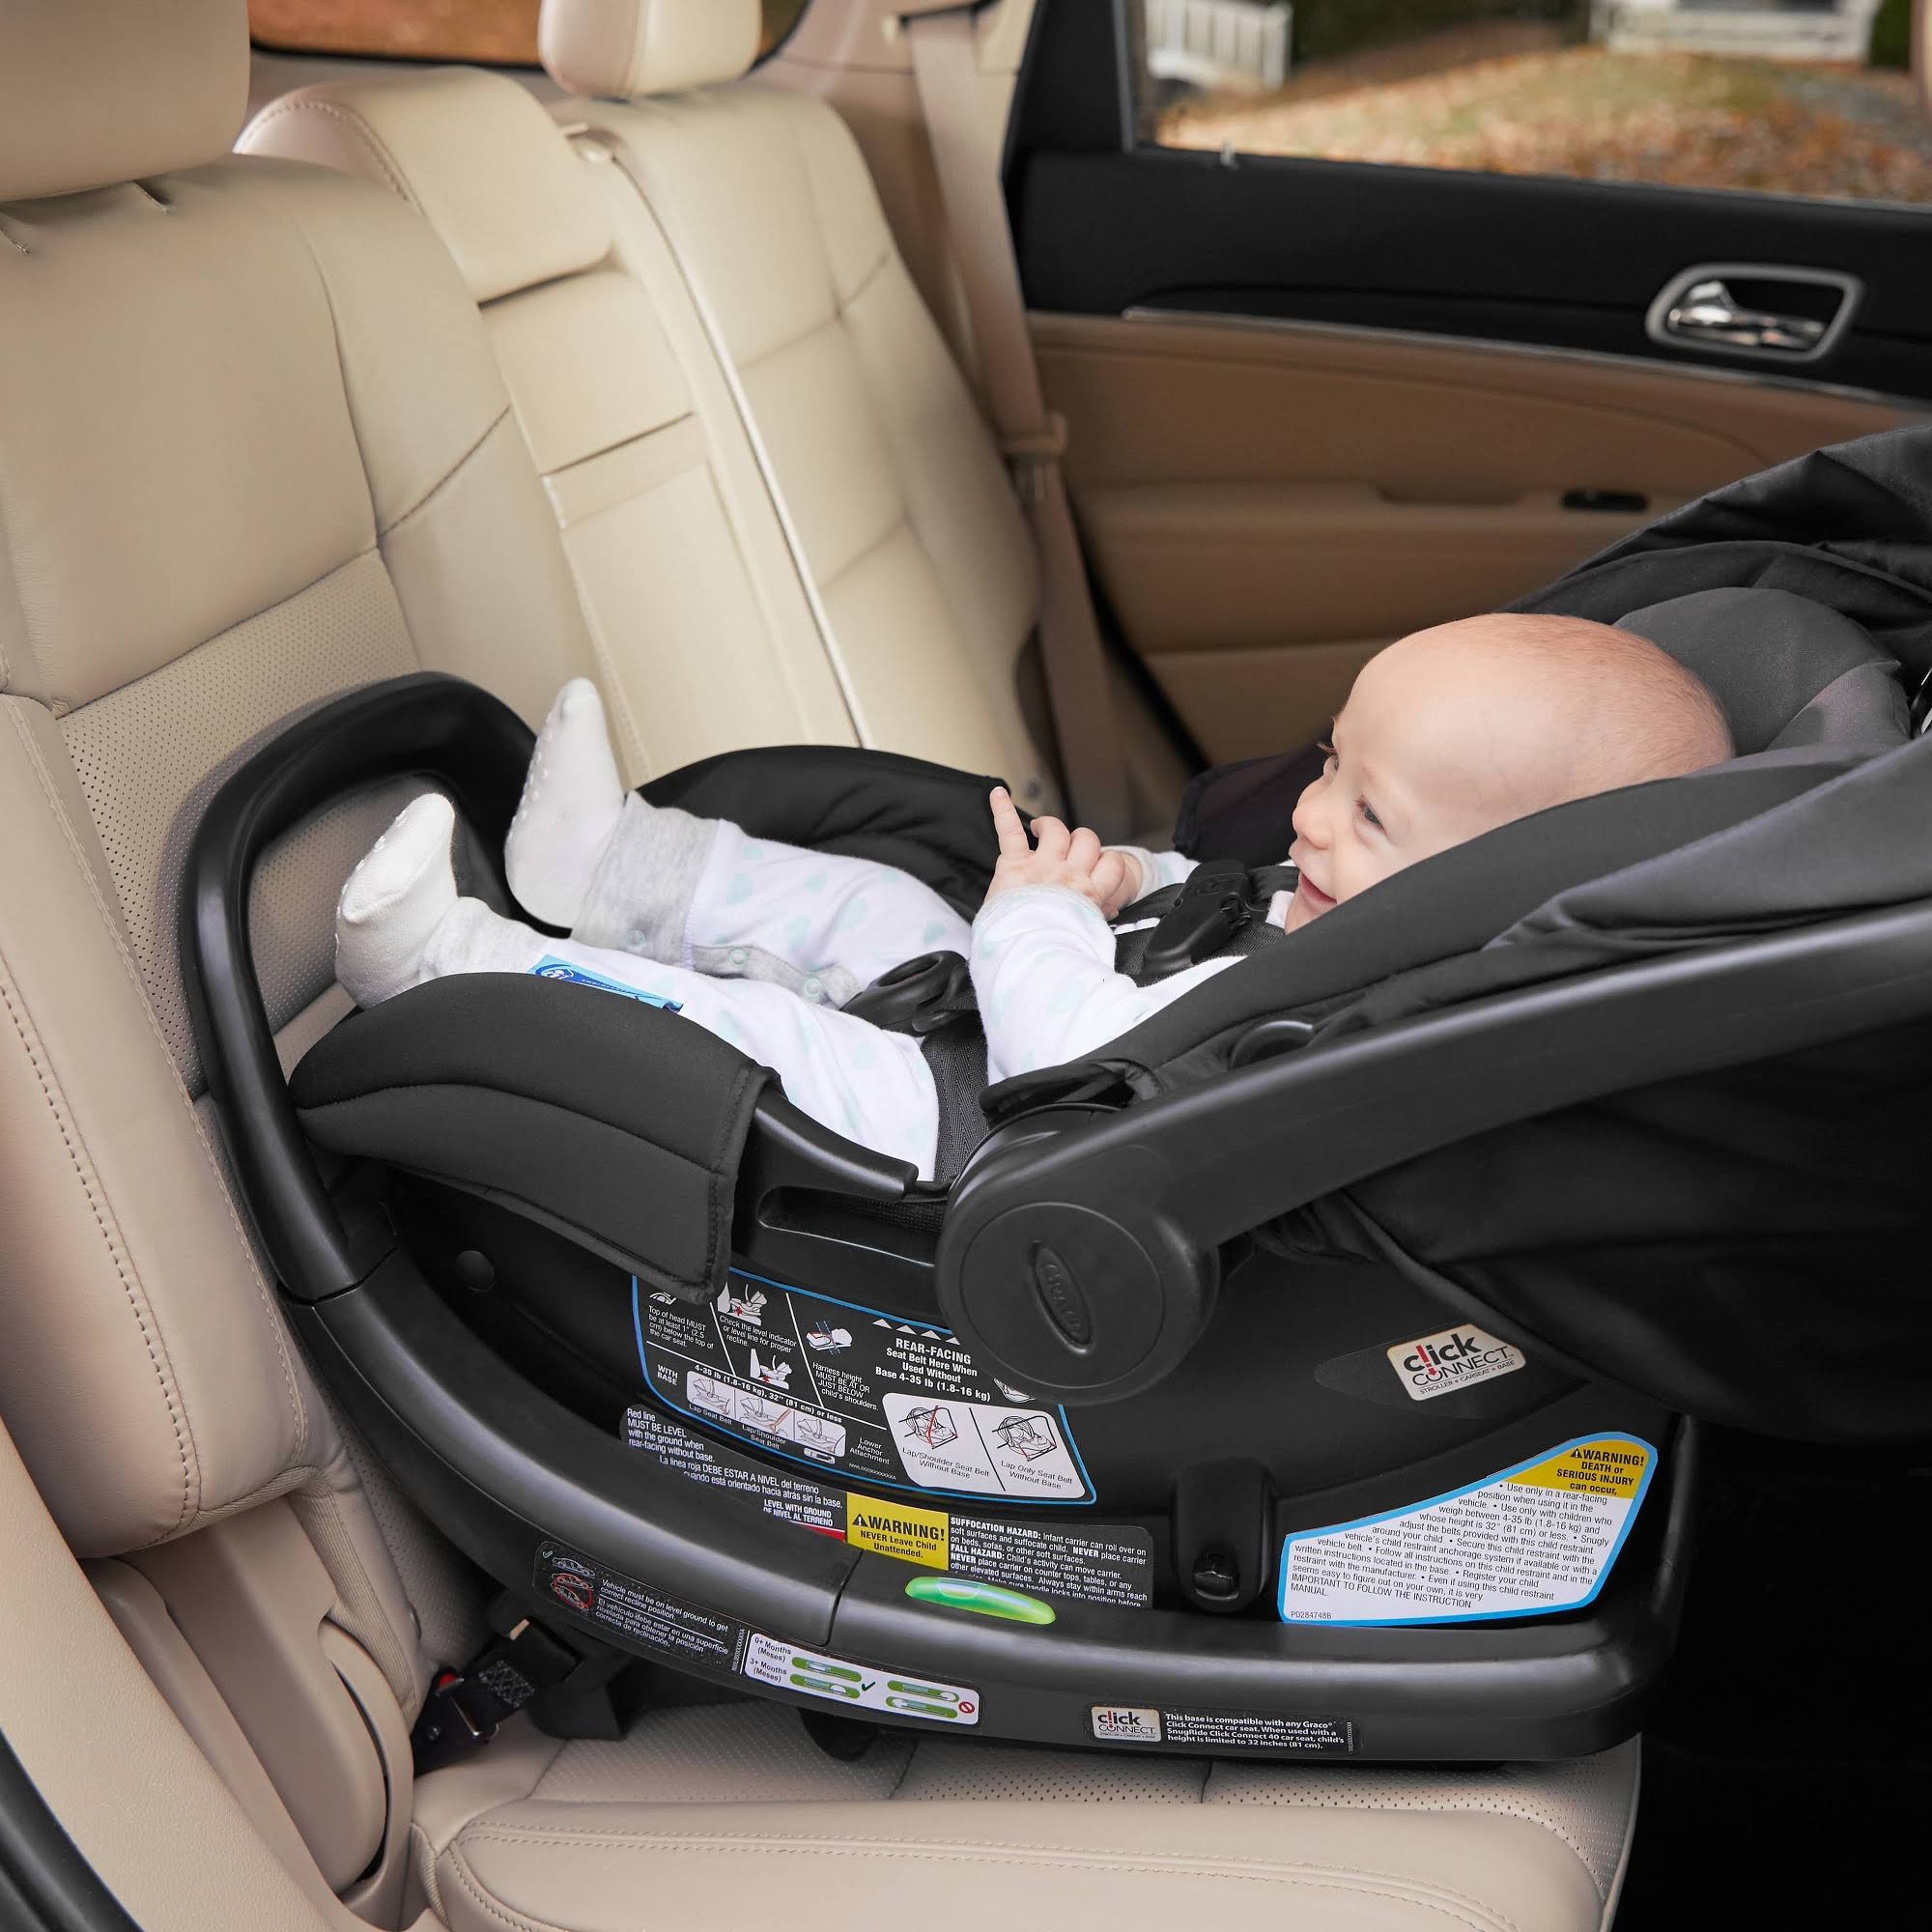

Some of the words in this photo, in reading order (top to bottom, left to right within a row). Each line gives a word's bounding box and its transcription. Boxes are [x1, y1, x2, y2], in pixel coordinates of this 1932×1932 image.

[719, 1315, 740, 1327] Check
[741, 1322, 751, 1331] the
[753, 1326, 767, 1337] level
[768, 1332, 796, 1347] indicator
[726, 1334, 749, 1347] recline.
[731, 1326, 746, 1337] level
[747, 1333, 758, 1342] line
[770, 1342, 791, 1352] proper
[896, 1338, 970, 1364] REAR-FACING
[1404, 1334, 1482, 1372] click
[658, 1364, 677, 1378] WITH
[812, 1361, 839, 1376] Harness
[841, 1371, 862, 1383] height
[887, 1348, 906, 1359] Seat
[909, 1353, 925, 1364] Belt
[929, 1357, 950, 1370] Here
[952, 1363, 977, 1377] When
[902, 1362, 923, 1374] Used
[926, 1368, 960, 1382] Without
[1412, 1347, 1508, 1385] CONNECT
[657, 1372, 676, 1385] BASE
[815, 1370, 837, 1381] MUST
[838, 1378, 847, 1386] BE
[848, 1379, 858, 1389] AT
[859, 1384, 869, 1393] OR
[875, 1366, 896, 1378] Base
[899, 1373, 921, 1384] 4-35
[924, 1378, 933, 1387] lb
[937, 1381, 972, 1396] (1.8-16
[976, 1389, 990, 1401] kg)
[1420, 1380, 1453, 1394] STROLLER
[1461, 1368, 1490, 1382] CARSEAT
[1497, 1360, 1515, 1370] BASE
[695, 1364, 712, 1376] 4-35
[724, 1376, 751, 1390] (1.8-16
[769, 1392, 783, 1401] 32"
[785, 1399, 797, 1407] (81
[800, 1405, 814, 1414] cm)
[827, 1412, 841, 1423] less
[818, 1379, 837, 1389] JUST
[838, 1385, 864, 1398] BELOW
[821, 1388, 842, 1399] child's
[844, 1395, 878, 1410] shoulders.
[627, 1407, 641, 1418] Red
[643, 1411, 655, 1421] line
[628, 1418, 649, 1430] MUST
[651, 1423, 661, 1433] BE
[663, 1425, 687, 1437] LEVEL
[628, 1429, 642, 1437] with
[644, 1432, 655, 1440] the
[657, 1435, 682, 1446] ground
[684, 1439, 703, 1450] when
[629, 1438, 666, 1454] rear-facing
[668, 1446, 694, 1459] without
[696, 1451, 715, 1462] base.
[1582, 1449, 1644, 1466] WARNING!
[1001, 1461, 1015, 1469] Lap
[1018, 1464, 1036, 1475] Only
[1037, 1469, 1055, 1479] Seat
[1057, 1474, 1071, 1484] Belt
[1557, 1468, 1596, 1481] SERIOUS
[1600, 1474, 1634, 1486] INJURY
[1581, 1462, 1611, 1472] DEATH
[1009, 1471, 1039, 1484] Without
[1041, 1479, 1061, 1489] Base
[1590, 1485, 1616, 1495] occur,
[1478, 1491, 1510, 1501] position
[1513, 1495, 1535, 1504] when
[1538, 1499, 1560, 1510] using
[1563, 1501, 1568, 1510] it
[1580, 1503, 1593, 1512] the
[1507, 1483, 1522, 1492] Use
[1525, 1487, 1543, 1497] only
[1546, 1488, 1552, 1496] in
[1563, 1492, 1607, 1505] rear-facing
[764, 1499, 783, 1509] LEVEL
[784, 1502, 802, 1513] WITH
[804, 1506, 831, 1518] GROUND
[1459, 1498, 1487, 1508] vehicle.
[1501, 1503, 1517, 1513] Use
[1519, 1507, 1537, 1517] only
[1559, 1512, 1591, 1522] children
[1594, 1517, 1611, 1525] who
[867, 1516, 944, 1541] WARNING!
[1438, 1506, 1463, 1516] weigh
[1464, 1508, 1499, 1520] between
[1502, 1514, 1521, 1523] 4-35
[1535, 1519, 1566, 1529] (1.8-16
[1569, 1522, 1581, 1533] kg)
[861, 1530, 887, 1542] NEVER
[890, 1535, 913, 1547] Leave
[916, 1540, 936, 1550] Child
[951, 1517, 1004, 1533] SUFFOCATION
[1007, 1526, 1040, 1539] HAZARD:
[1043, 1532, 1063, 1543] Infant
[1065, 1537, 1088, 1547] carrier
[873, 1542, 923, 1557] Unattended.
[966, 1530, 997, 1541] surfaces
[1014, 1538, 1047, 1548] suffocate
[1049, 1544, 1067, 1552] child.
[1072, 1547, 1098, 1557] NEVER
[1101, 1551, 1120, 1560] place
[1122, 1555, 1146, 1564] carrier
[1291, 1582, 1328, 1596] MANUAL.
[1292, 1573, 1341, 1587] IMPORTANT
[1344, 1581, 1354, 1590] TO
[1356, 1583, 1392, 1596] FOLLOW
[1396, 1589, 1410, 1599] THE
[1413, 1592, 1470, 1607] INSTRUCTION
[602, 1578, 626, 1593] Vehicle
[627, 1590, 644, 1601] must
[645, 1596, 654, 1605] be
[666, 1604, 682, 1614] level
[683, 1611, 707, 1623] ground
[716, 1623, 727, 1632] get
[1291, 1610, 1331, 1619] PD284748B
[757, 1646, 785, 1662] (Meses)
[765, 1640, 791, 1654] Months
[753, 1666, 781, 1682] (Meses)
[760, 1661, 786, 1674] Months
[1097, 1710, 1142, 1725] click
[1165, 1714, 1182, 1722] This
[1099, 1724, 1155, 1734] CONNECT
